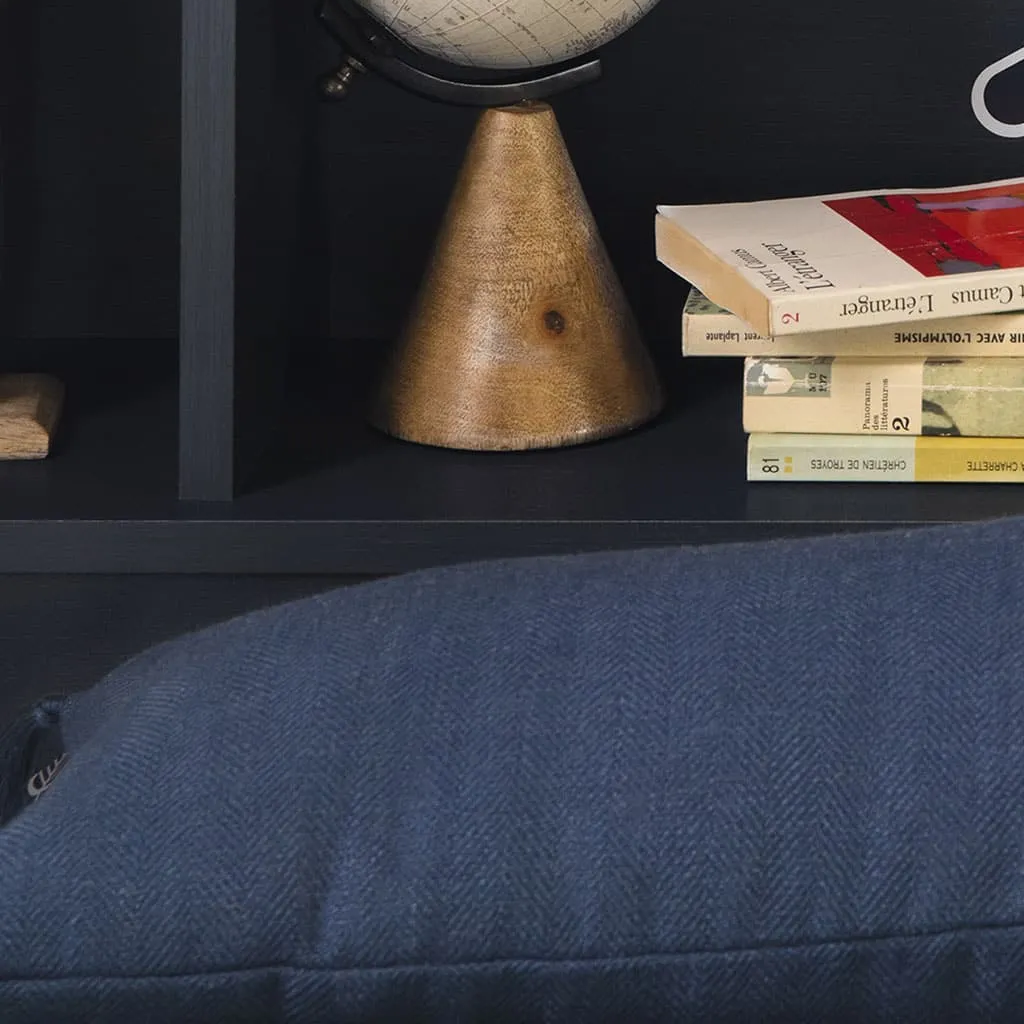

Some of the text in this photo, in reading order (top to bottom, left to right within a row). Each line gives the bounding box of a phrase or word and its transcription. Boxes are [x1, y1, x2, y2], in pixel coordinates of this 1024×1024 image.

[761, 242, 836, 291] L'étranger
[757, 269, 796, 293] Albert
[952, 287, 1013, 304] Camus
[839, 294, 934, 317] L'étranger
[781, 312, 800, 325] 2
[706, 330, 740, 343] Laplante
[893, 332, 972, 344] L'OLYMPISME
[976, 332, 1005, 344] AVEC
[872, 414, 880, 431] des
[891, 416, 910, 432] 2
[761, 456, 780, 474] 81
[811, 459, 907, 471] CHRÉTIEN DE TROYES
[967, 461, 1019, 471] CHARRETTE
